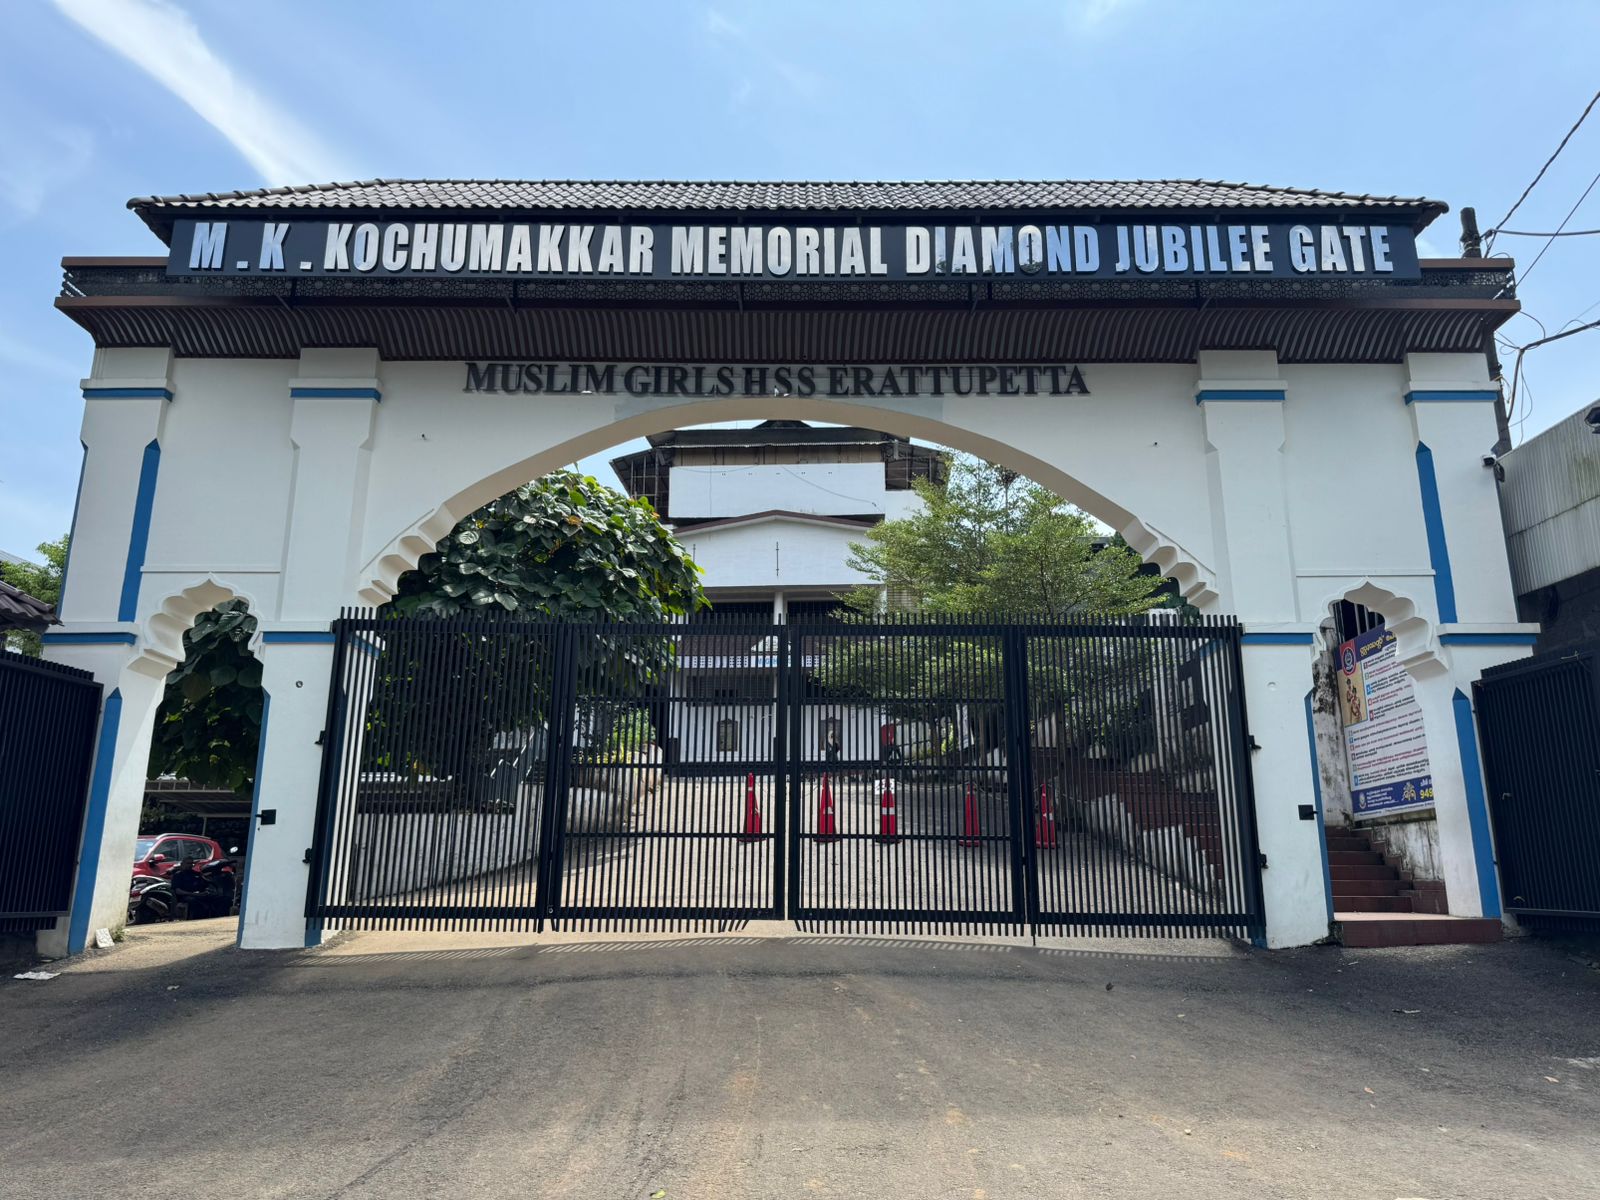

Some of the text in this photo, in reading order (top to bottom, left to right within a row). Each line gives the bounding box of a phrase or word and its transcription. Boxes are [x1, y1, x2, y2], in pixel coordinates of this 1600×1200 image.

[324, 223, 655, 273] KOCHUMAKKAR
[671, 226, 888, 276] MEMORIAL
[906, 225, 1100, 275] DIAMOND
[1115, 225, 1274, 272] JUBILEE
[1289, 225, 1394, 273] GATE
[463, 361, 1091, 397] MUSLIM GIRLS HSS ERATTUPETTA
